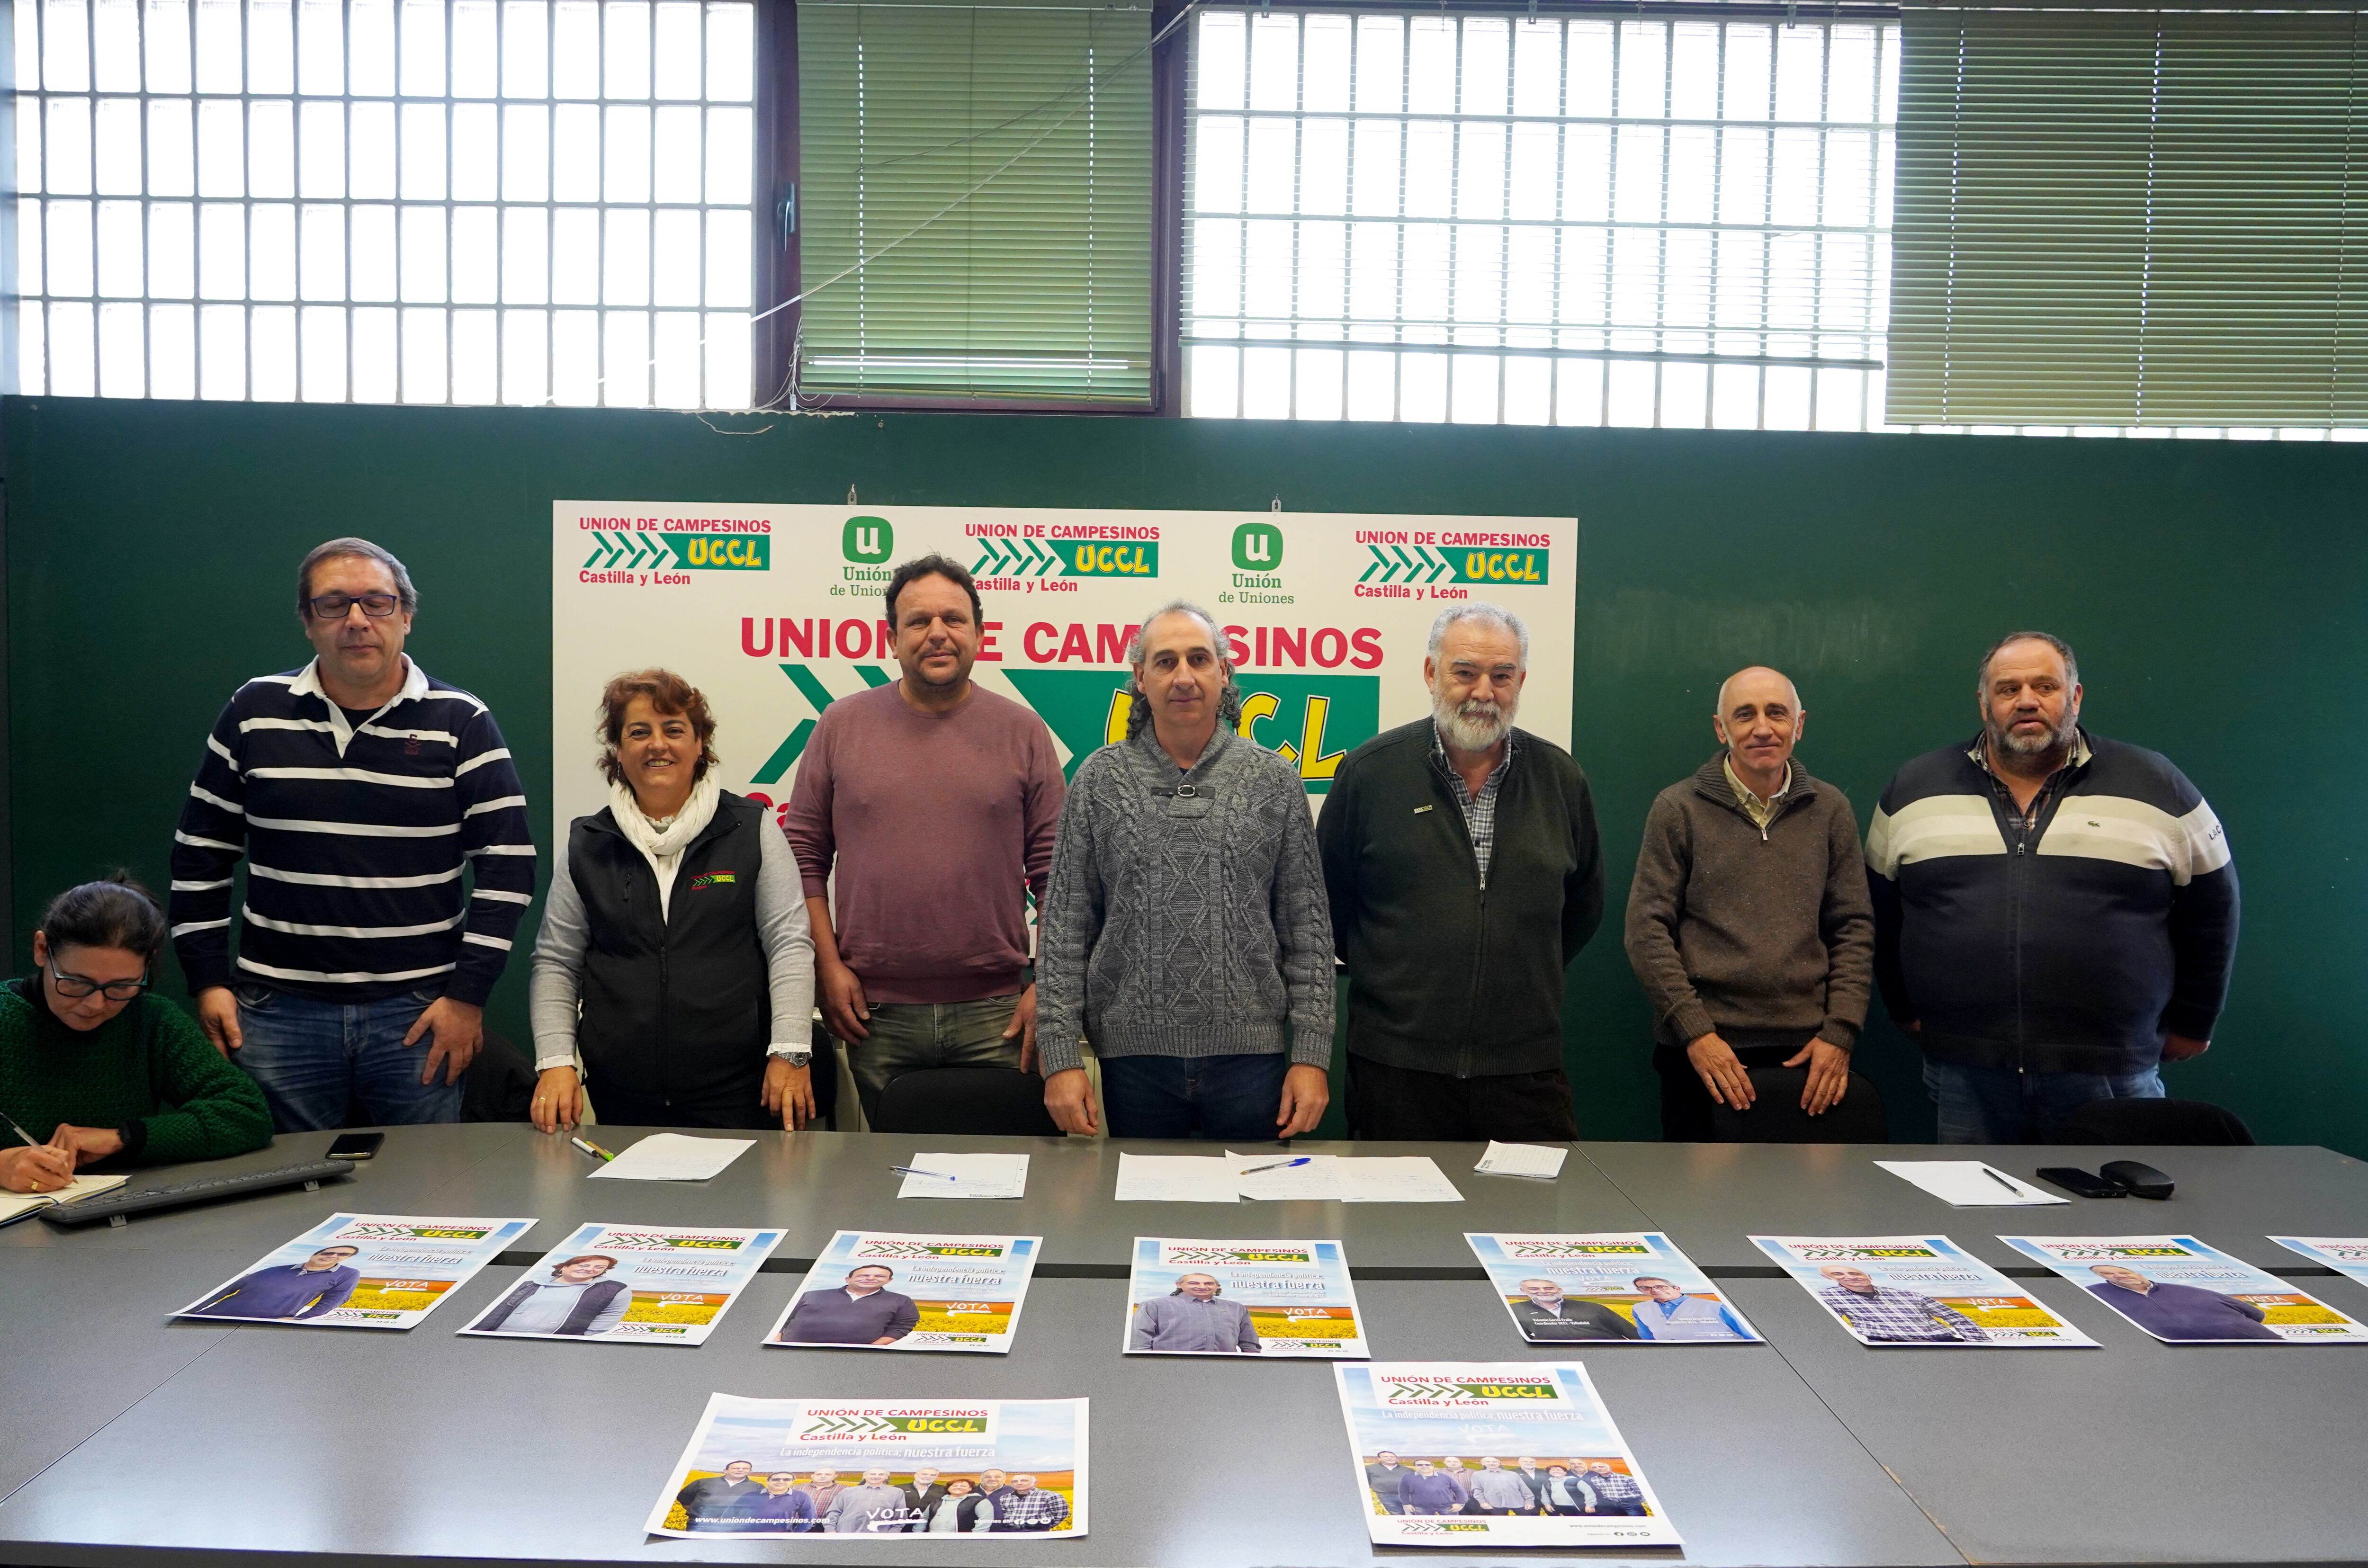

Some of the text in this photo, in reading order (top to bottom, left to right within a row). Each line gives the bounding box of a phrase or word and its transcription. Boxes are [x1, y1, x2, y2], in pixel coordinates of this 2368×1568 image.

[579, 517, 771, 533] UNION DE CAMPESINOS
[965, 523, 1160, 540] UNION DE CAMPESINOS
[1355, 530, 1551, 547] UNION DE CAMPESINOS
[687, 537, 762, 567] UCCL
[1075, 543, 1151, 574] UCCL
[1465, 551, 1540, 582] UCCL
[579, 570, 691, 587] Castilla y León
[843, 565, 893, 582] Unión
[1026, 581, 1035, 594] y
[1041, 578, 1078, 592] León
[1232, 573, 1282, 588] Unión
[830, 584, 845, 596] de
[1354, 583, 1468, 601] Castilla y León
[1219, 591, 1294, 604] de Uniones
[974, 622, 1003, 662] E
[1023, 622, 1384, 670] CAMSINOS
[422, 1229, 476, 1239] UCCL
[678, 1239, 733, 1249] UCCL
[940, 1247, 995, 1257] UCCL
[1247, 1253, 1304, 1262] UCCL
[366, 1254, 463, 1264] nuestra fuerza
[633, 1265, 728, 1277] nuestra fuerza
[1545, 1266, 1641, 1275] nuestra fuerza
[386, 1280, 428, 1288] VOTA
[907, 1273, 1001, 1285] nuestra fuerza
[1229, 1280, 1325, 1290] nuestra fuerza
[660, 1293, 704, 1301] VOTA
[1965, 1298, 2011, 1306] VOTA
[2242, 1295, 2288, 1303] VOTA
[946, 1302, 990, 1310] VOTA
[1282, 1307, 1328, 1316] VOTA
[1381, 1375, 1430, 1383] UNIÓN
[1481, 1385, 1552, 1398] UCCL
[807, 1408, 860, 1416] UNIÓN
[1381, 1410, 1393, 1419] La
[1394, 1410, 1459, 1420] independencia
[1496, 1411, 1543, 1421] nuestra
[1543, 1410, 1584, 1421] fuerza
[907, 1419, 978, 1432] UCCL
[1458, 1424, 1510, 1434] VOTA
[800, 1433, 907, 1443] Castilla y León
[780, 1447, 791, 1456] La
[793, 1446, 861, 1458] independencia
[904, 1448, 953, 1458] nuestra
[955, 1446, 995, 1457] fuerza
[866, 1507, 926, 1520] VOTA
[694, 1516, 830, 1525] www.uniondecampesinos.com
